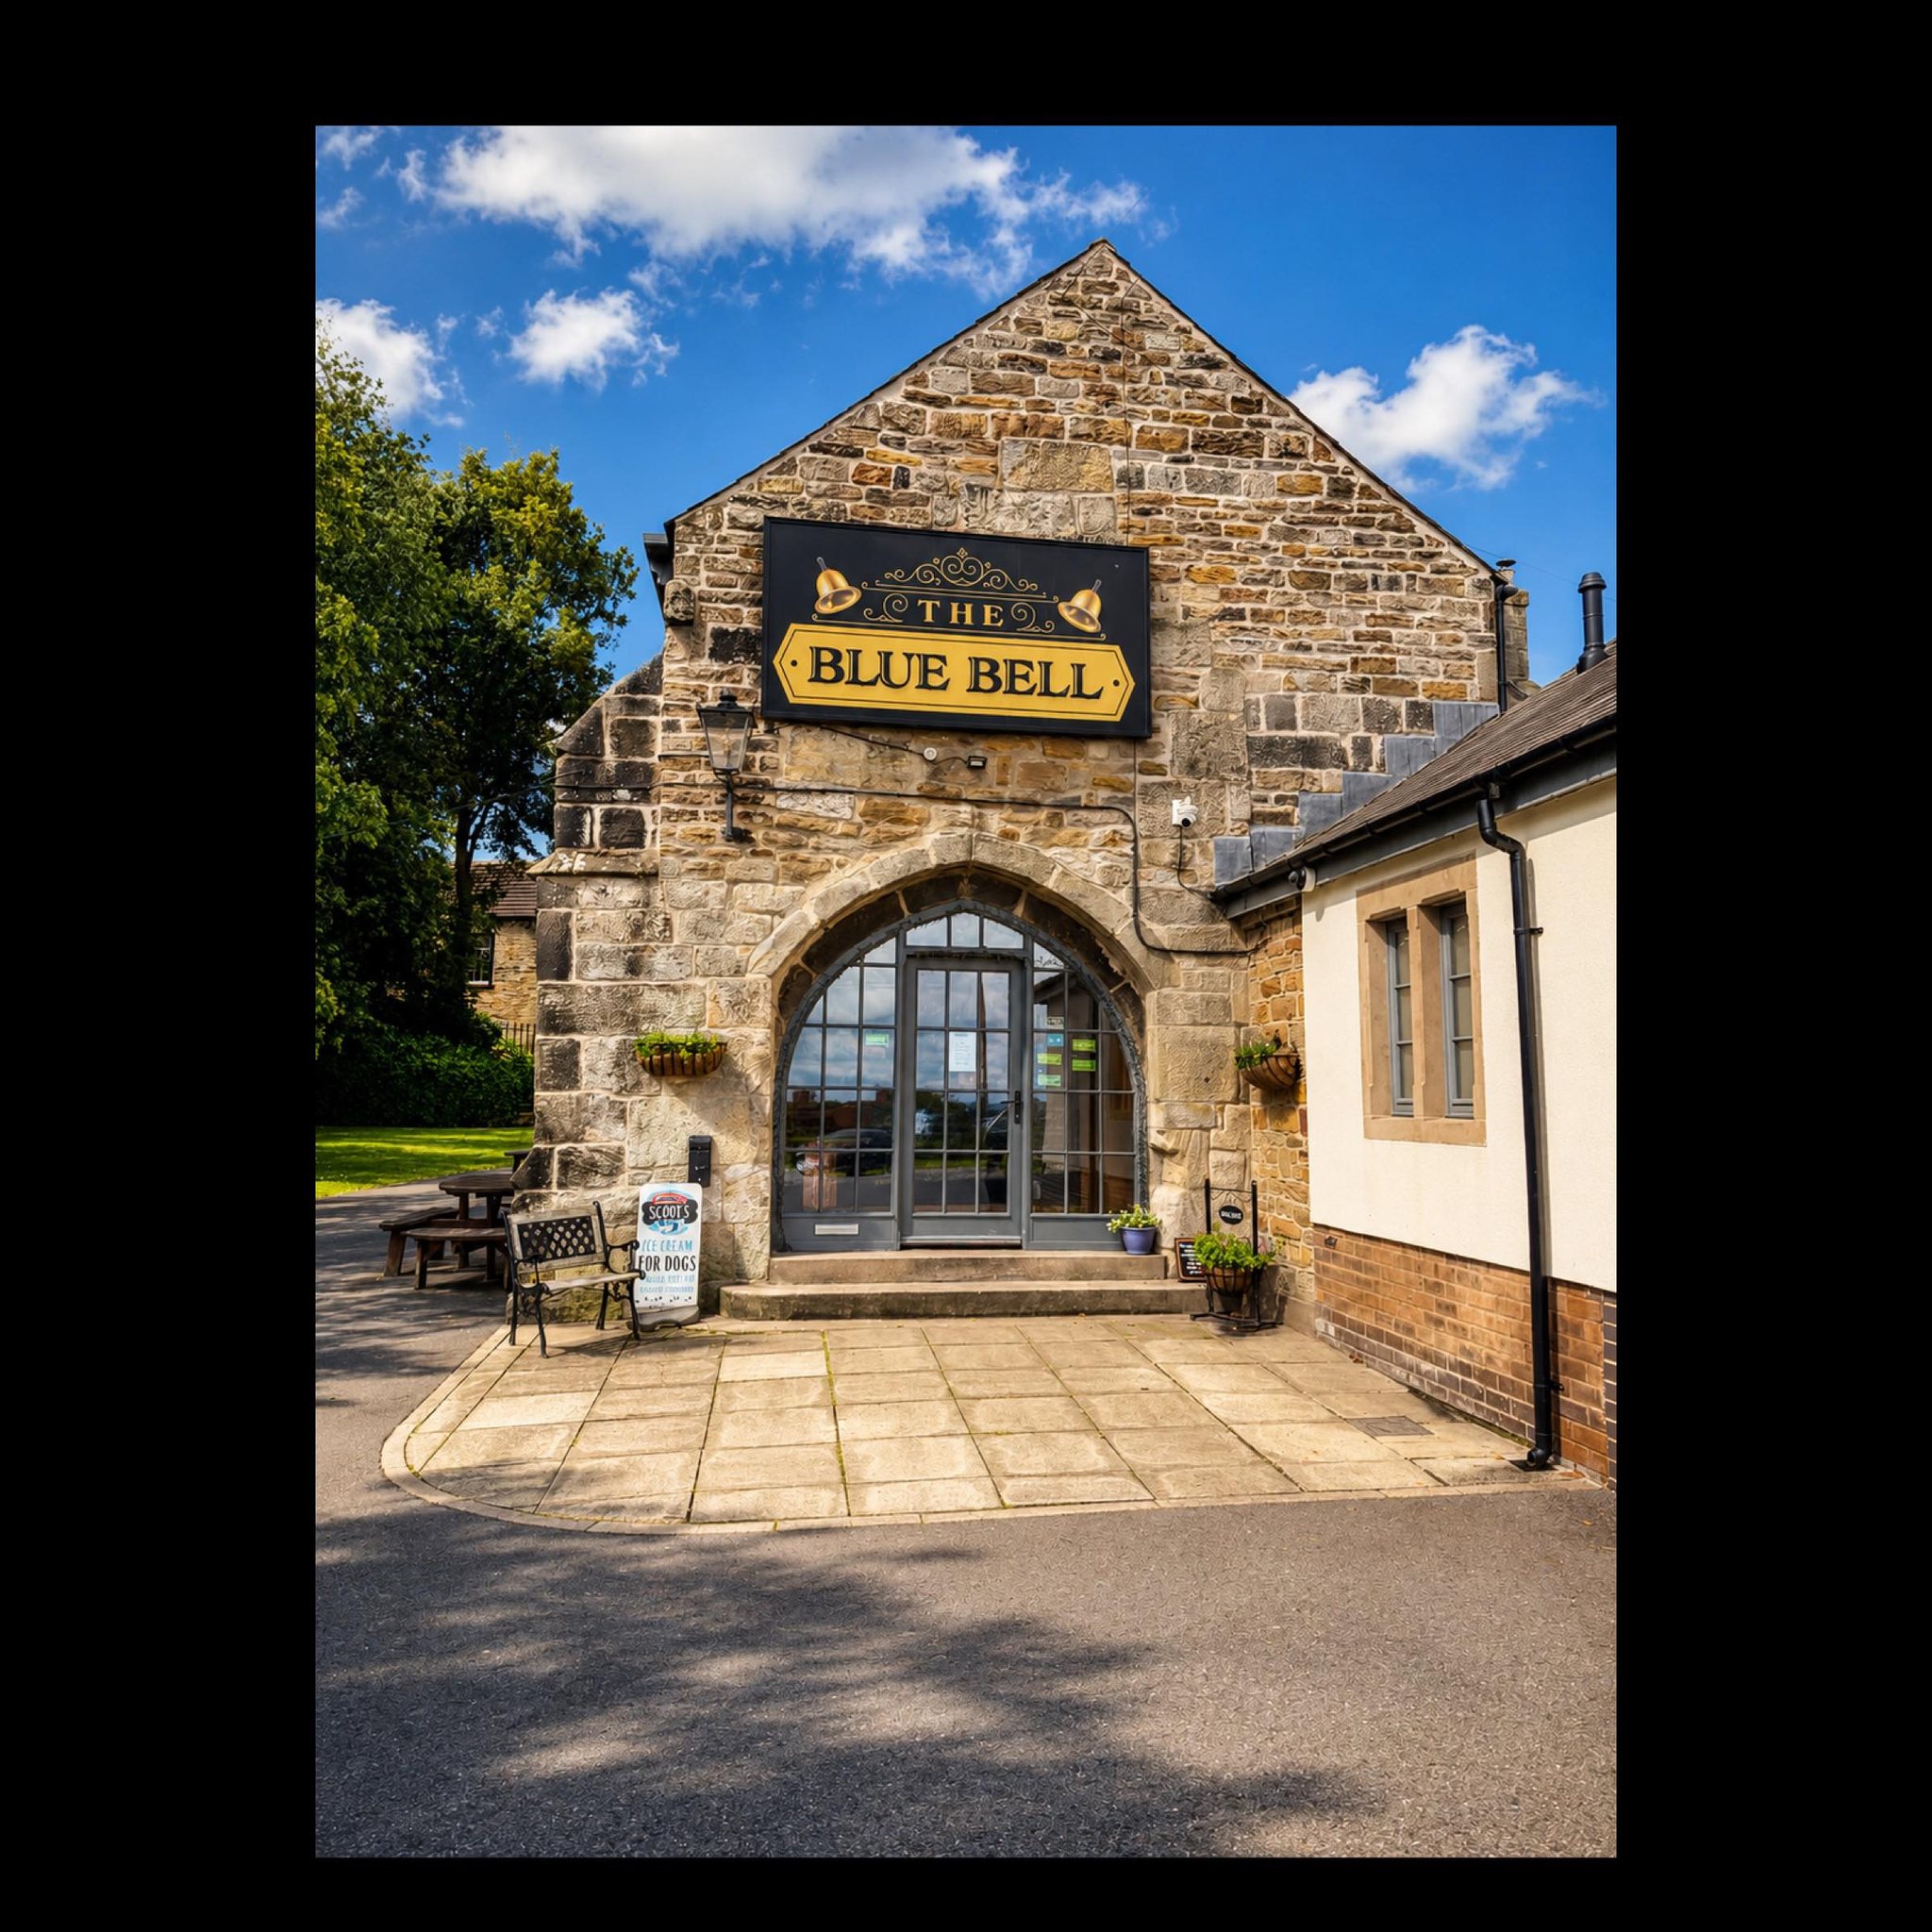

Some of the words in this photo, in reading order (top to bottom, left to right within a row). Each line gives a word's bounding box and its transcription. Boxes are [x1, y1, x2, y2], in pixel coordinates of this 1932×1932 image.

[917, 599, 1004, 626] THE
[808, 645, 950, 691] BLUE
[966, 657, 1105, 700] BELL
[641, 1239, 658, 1252] ICE
[660, 1240, 692, 1252] CREAM
[639, 1255, 660, 1272] FOR
[665, 1255, 696, 1272] DOGS
